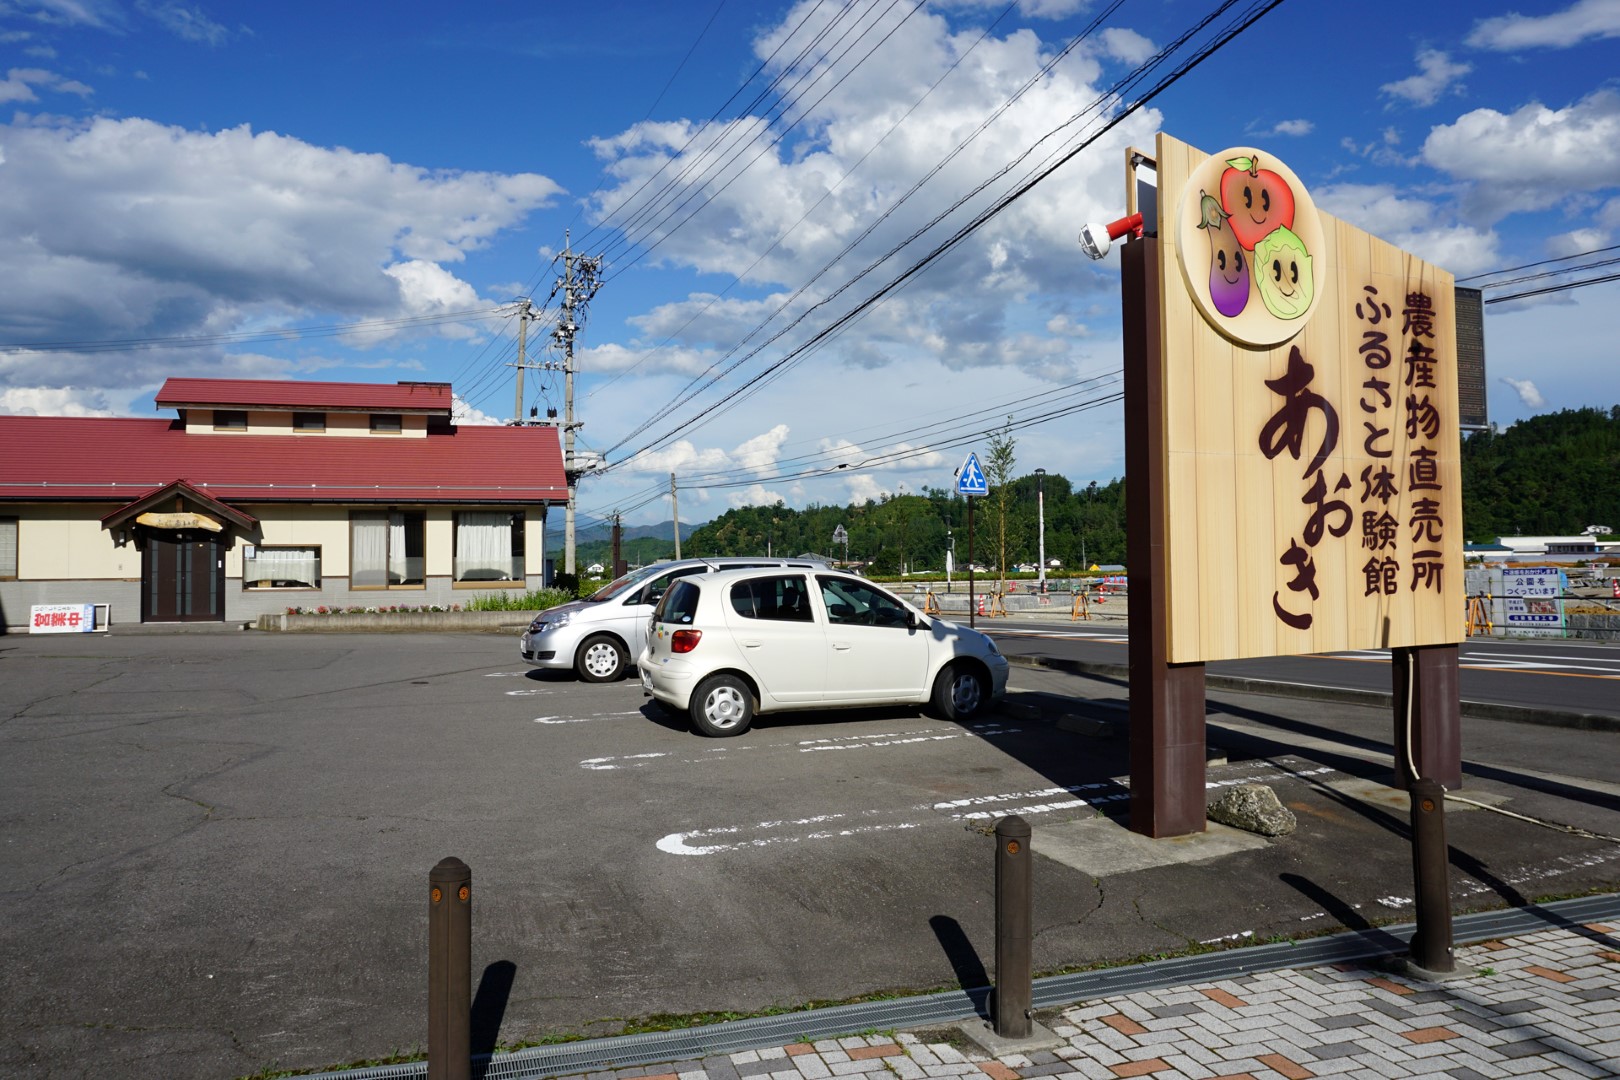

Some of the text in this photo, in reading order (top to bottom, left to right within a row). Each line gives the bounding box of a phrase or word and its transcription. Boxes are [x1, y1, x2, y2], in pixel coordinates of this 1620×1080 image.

[1258, 345, 1354, 630] あおき
[1355, 285, 1400, 598] ふるさと体験館
[1401, 291, 1444, 595] 農産物直売所
[1515, 577, 1546, 586] 公園を
[34, 612, 83, 627] 営業中
